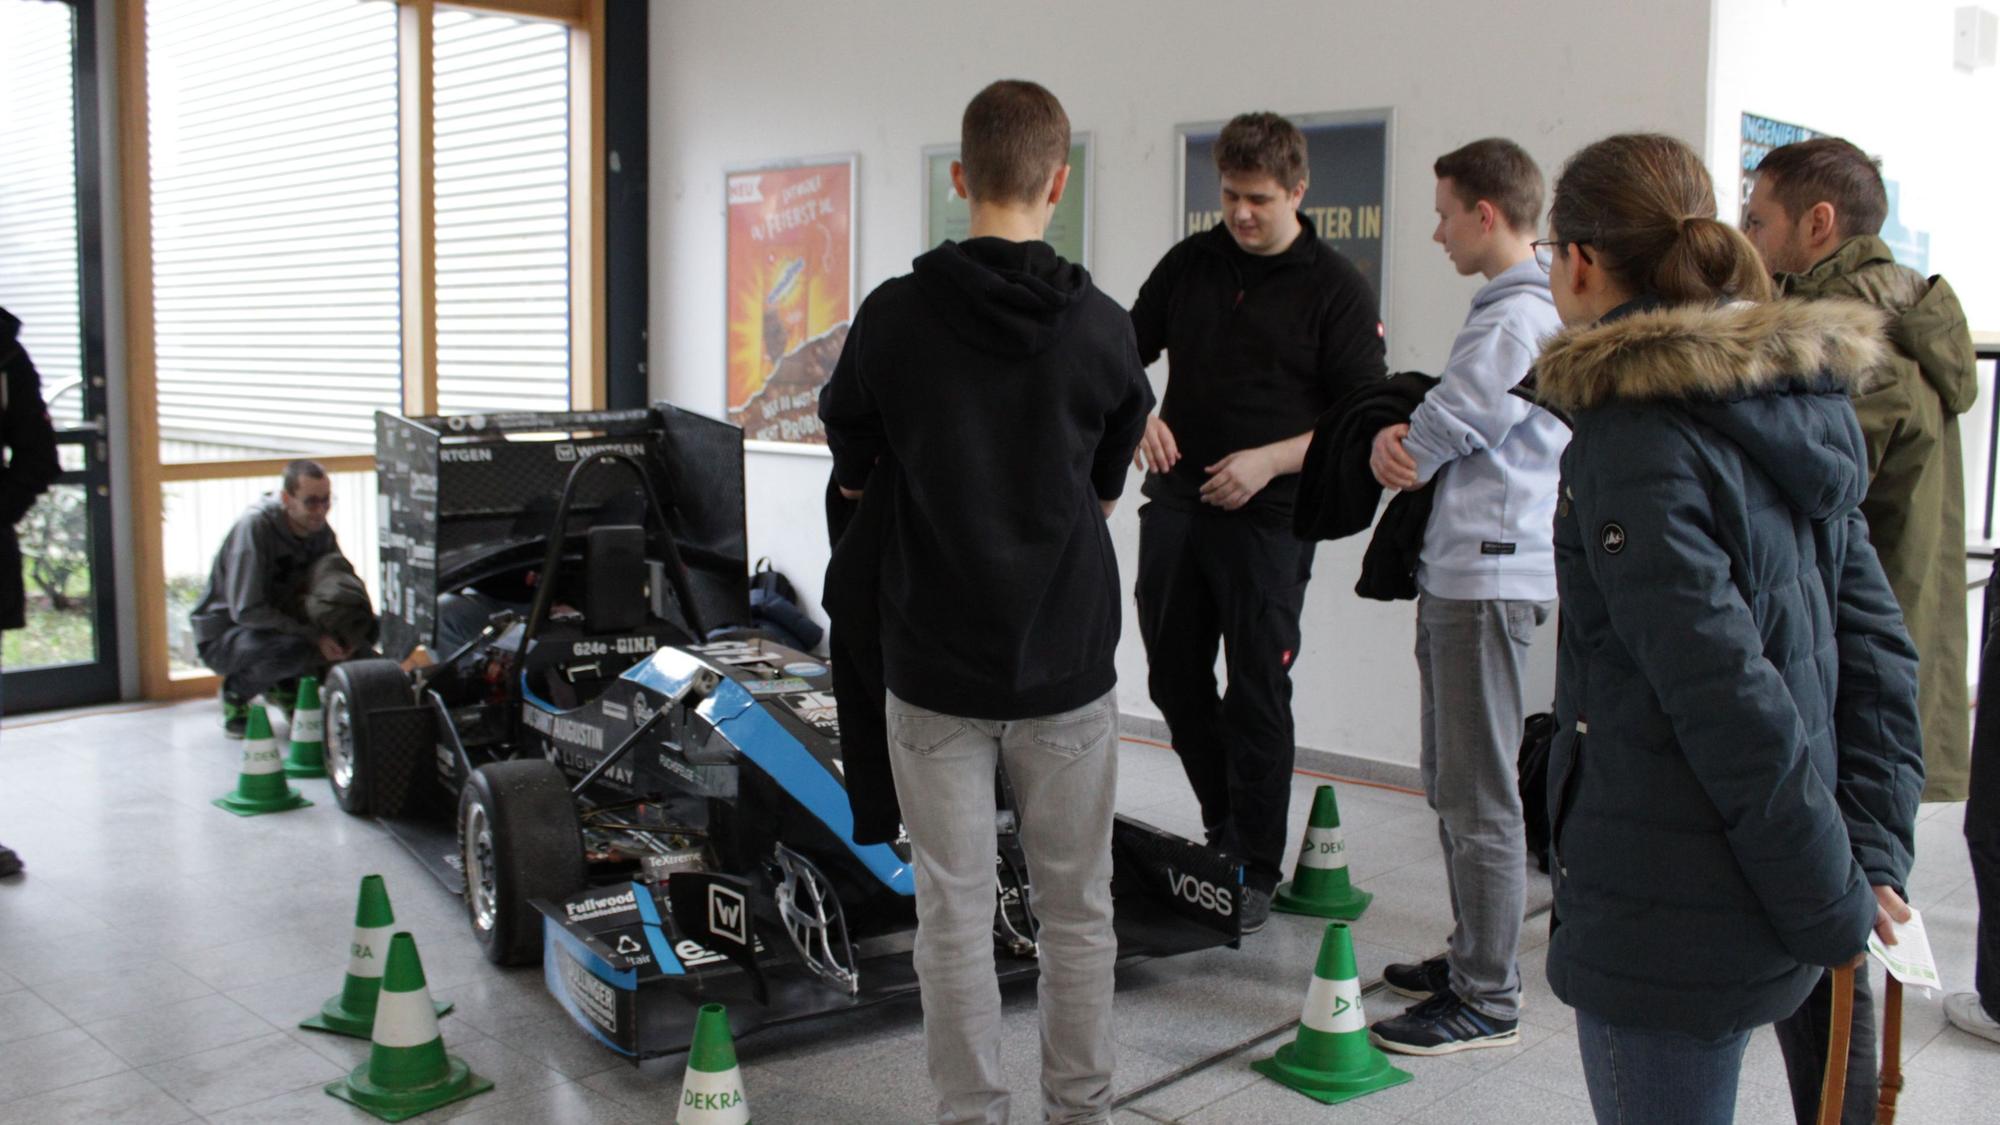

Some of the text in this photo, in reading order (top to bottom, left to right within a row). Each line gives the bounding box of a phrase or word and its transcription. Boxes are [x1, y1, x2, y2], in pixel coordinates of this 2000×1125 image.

[1304, 207, 1352, 239] TER
[1358, 205, 1381, 239] IN
[553, 716, 604, 751] AUGUSTIN
[565, 890, 635, 915] Fullwood
[1167, 868, 1232, 916] VOSS
[684, 1088, 742, 1110] DEKRA
